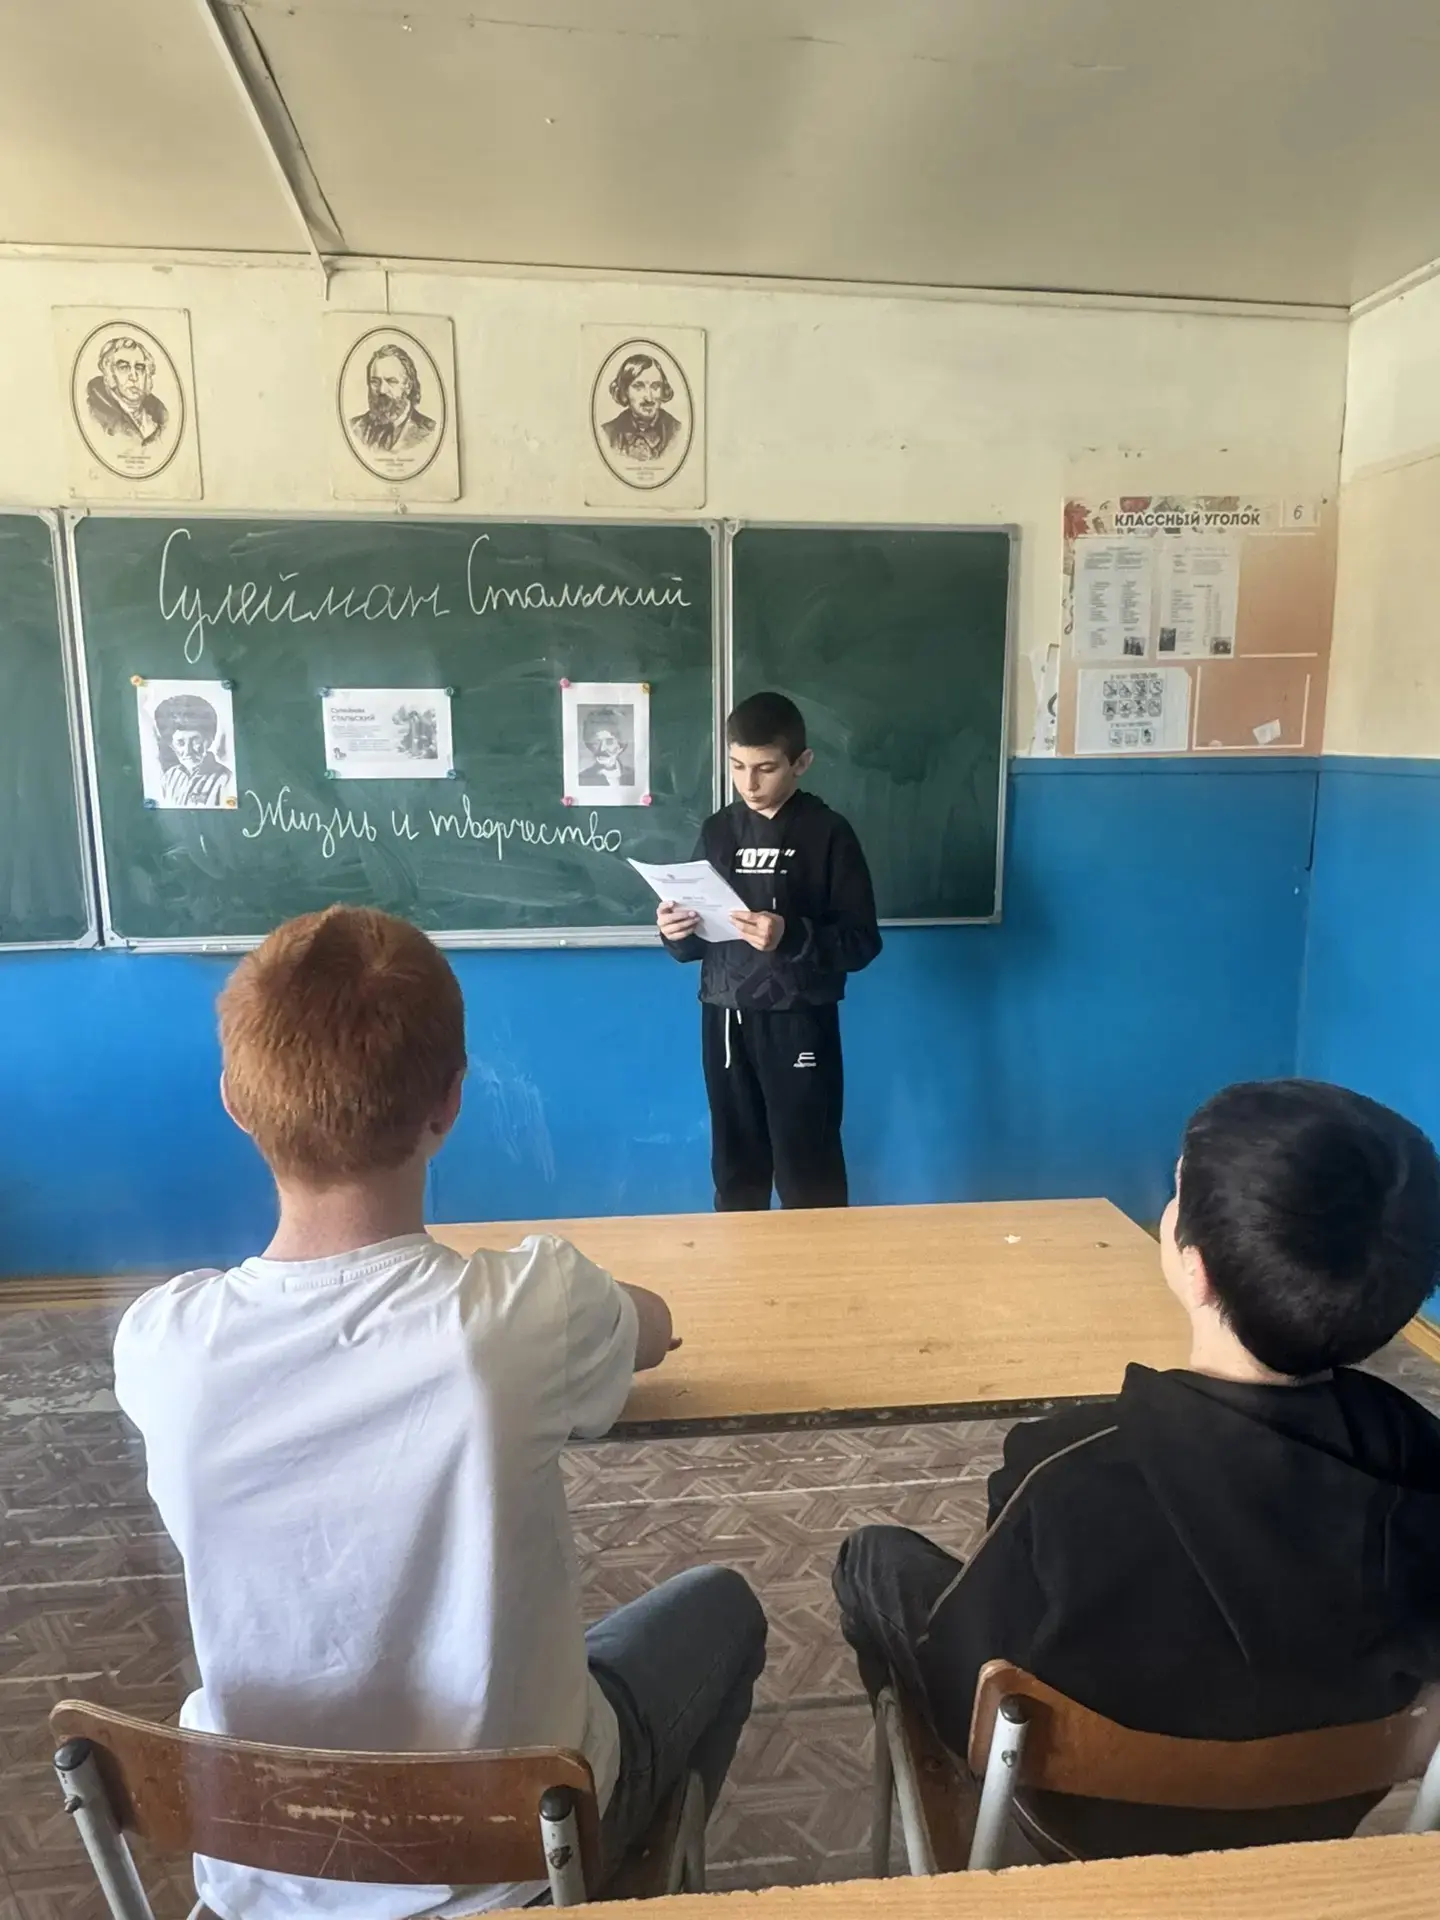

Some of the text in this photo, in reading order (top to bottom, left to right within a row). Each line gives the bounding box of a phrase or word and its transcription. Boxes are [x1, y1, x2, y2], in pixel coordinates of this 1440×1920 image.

[1114, 510, 1260, 527] КЛАССНЫЙ УГОЛОК
[159, 528, 692, 664] Сулейман Стальский
[242, 785, 622, 861] Жизнь и творчество
